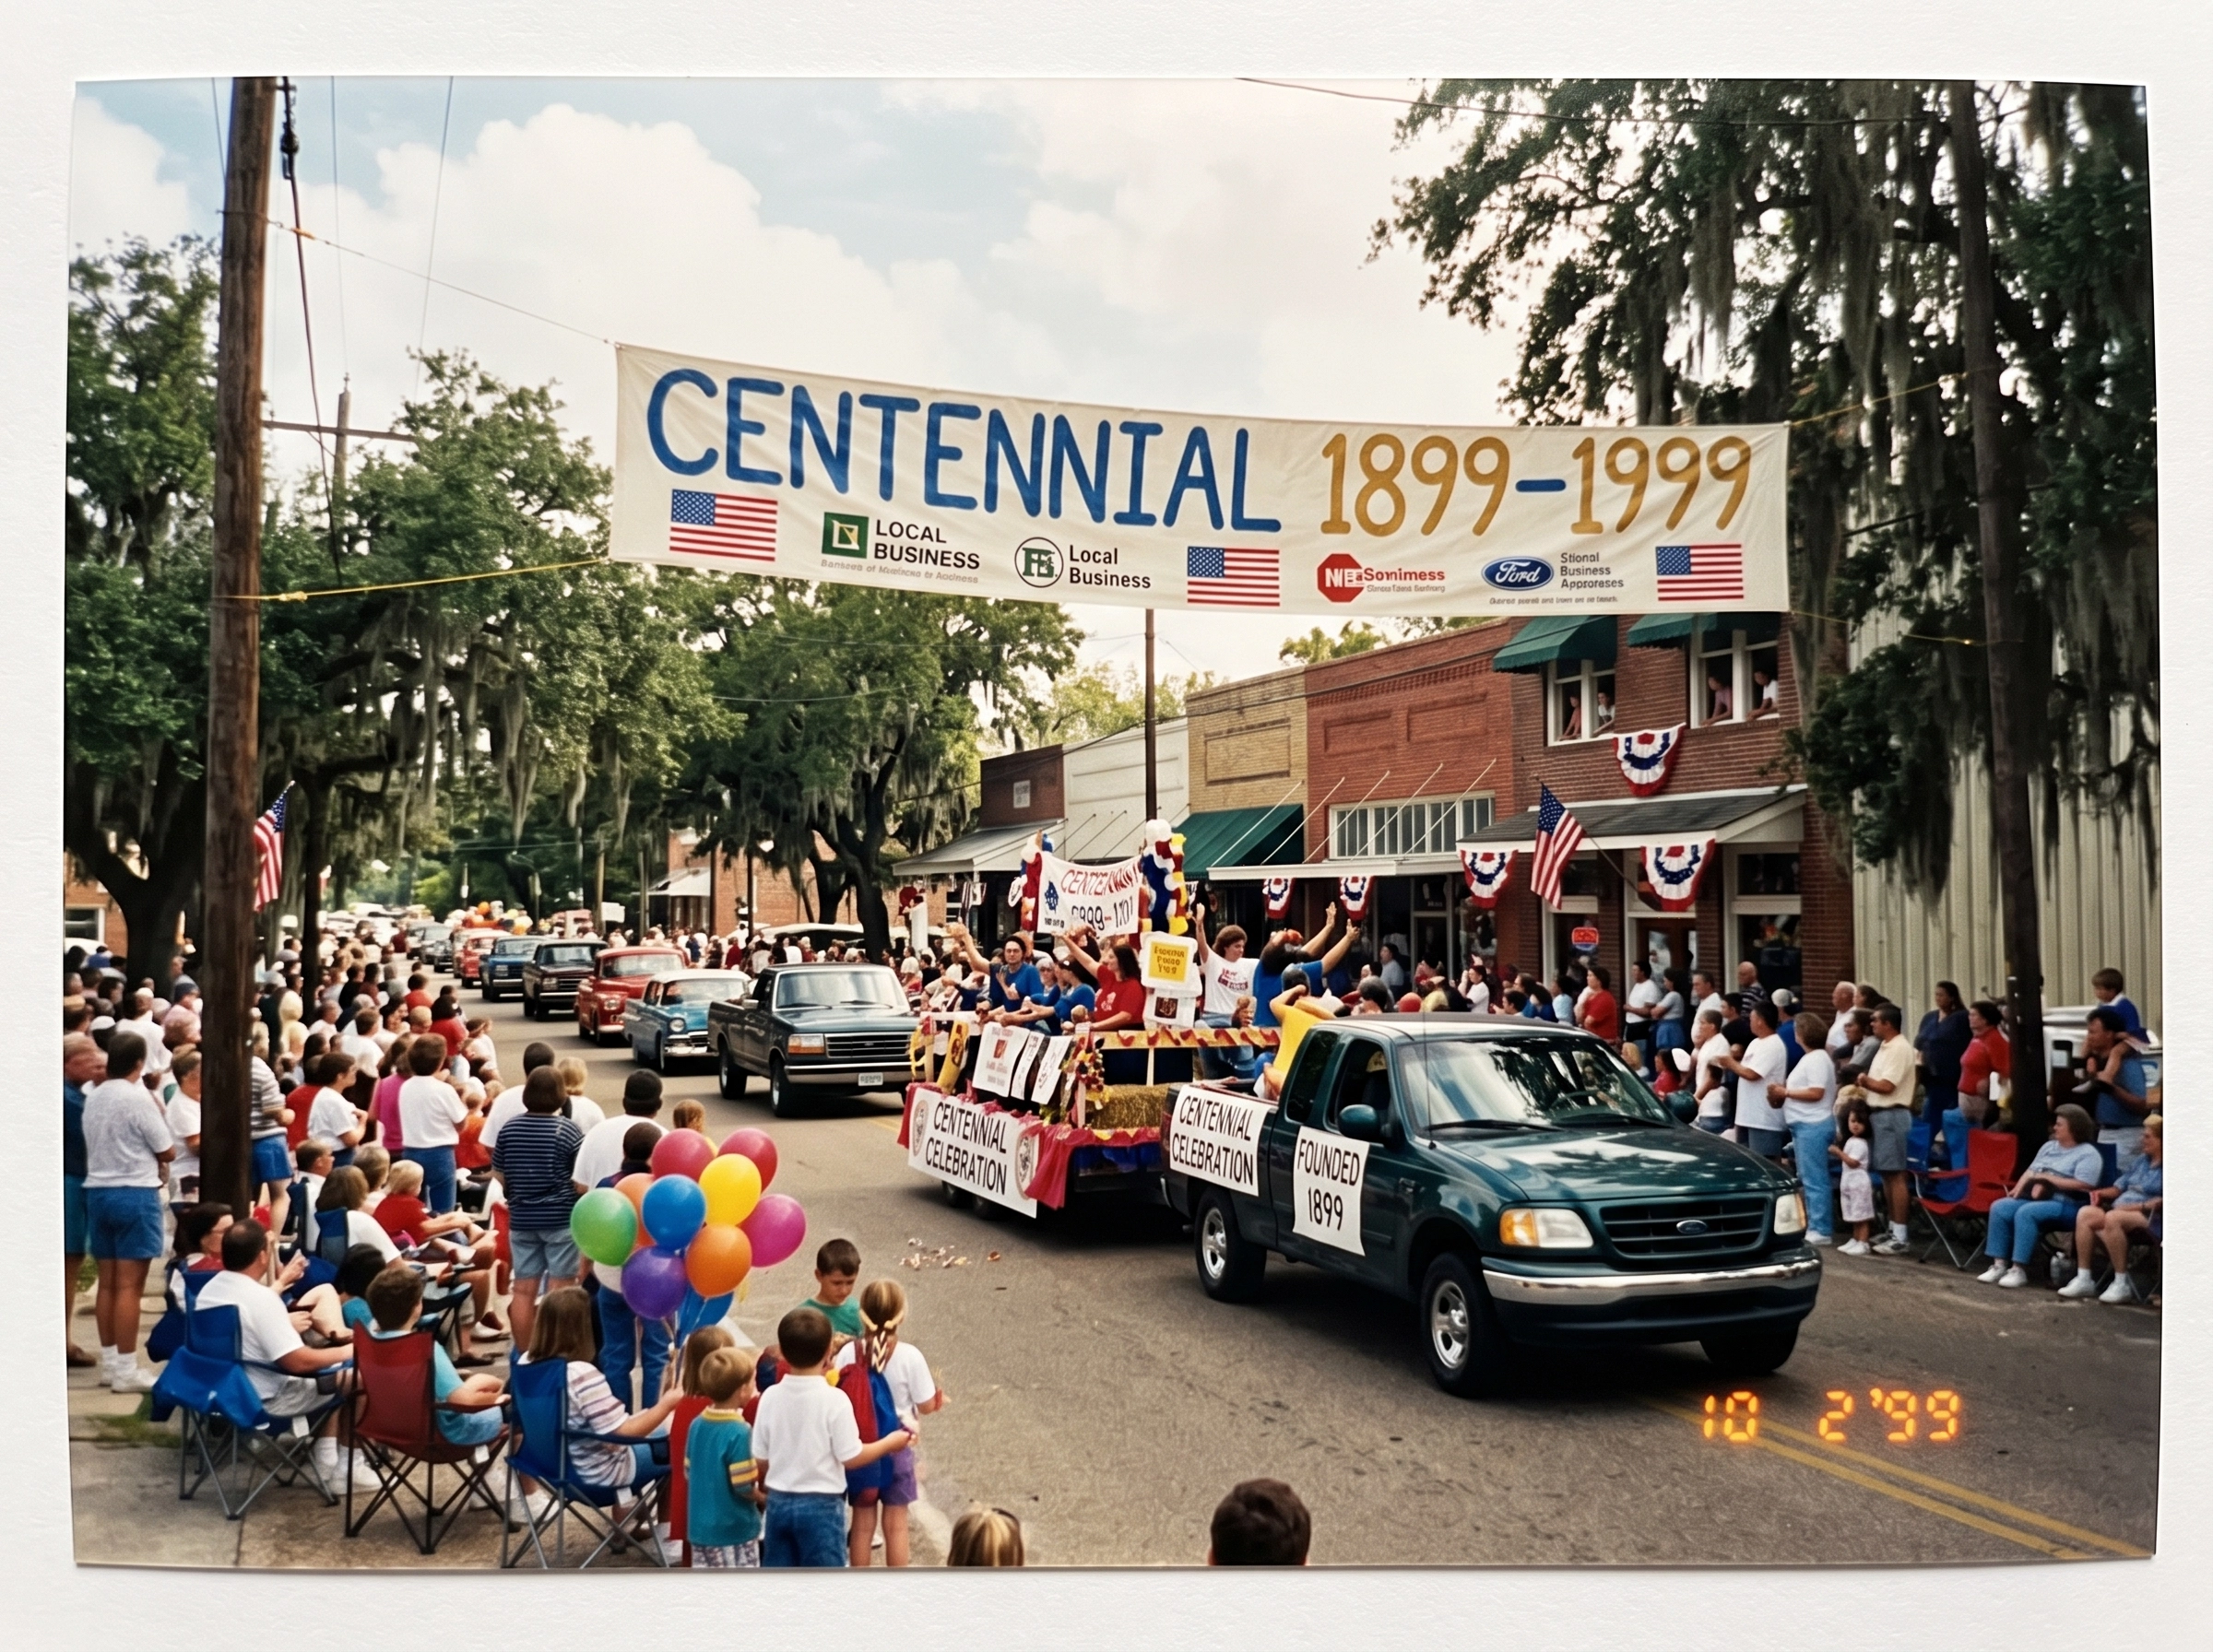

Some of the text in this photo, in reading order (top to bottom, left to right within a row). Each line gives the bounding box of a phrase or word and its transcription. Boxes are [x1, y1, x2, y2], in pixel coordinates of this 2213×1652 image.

[647, 369, 1752, 537] CENTENNIAL 1899-1999
[875, 519, 947, 543] LOCAL
[874, 542, 980, 570] BUSINESS
[1069, 545, 1118, 564] Local
[1494, 560, 1542, 583] Ford
[1560, 565, 1612, 577] Business
[1069, 567, 1152, 589] Business
[933, 1101, 1007, 1154] CENTENNIAL
[1180, 1095, 1254, 1141] CENTENNIAL
[925, 1137, 1007, 1196] CELEBRATION
[1172, 1133, 1254, 1186] CELEBRATION
[1297, 1139, 1360, 1186] FOUNDED
[1308, 1186, 1344, 1231] 1899
